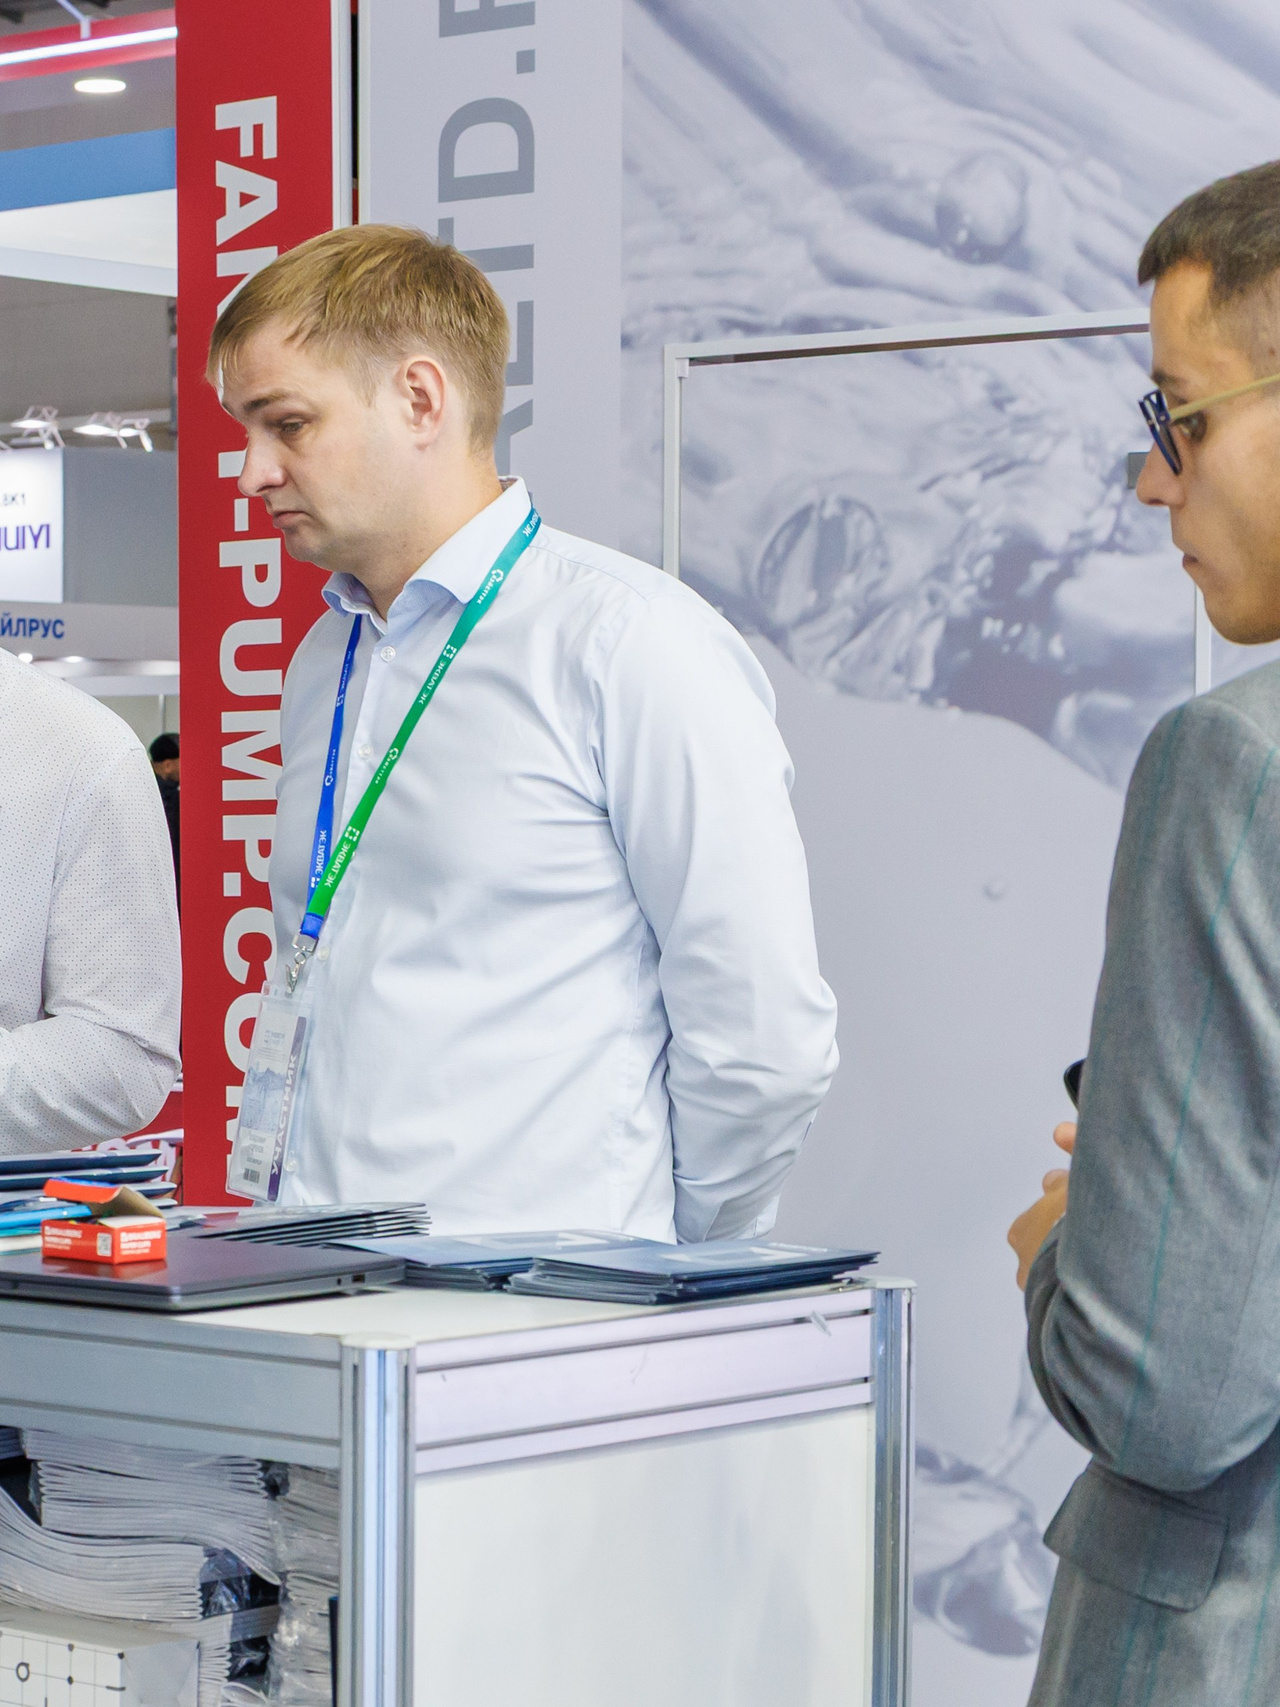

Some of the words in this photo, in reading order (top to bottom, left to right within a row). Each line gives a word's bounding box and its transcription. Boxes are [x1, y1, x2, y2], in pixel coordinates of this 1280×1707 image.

[419, 659, 446, 704] ЭКВАТЭК
[315, 830, 327, 875] ЭКВАТЭК
[324, 841, 351, 887] ЭКВАТЭК
[270, 1054, 297, 1176] УЧАСТНИК
